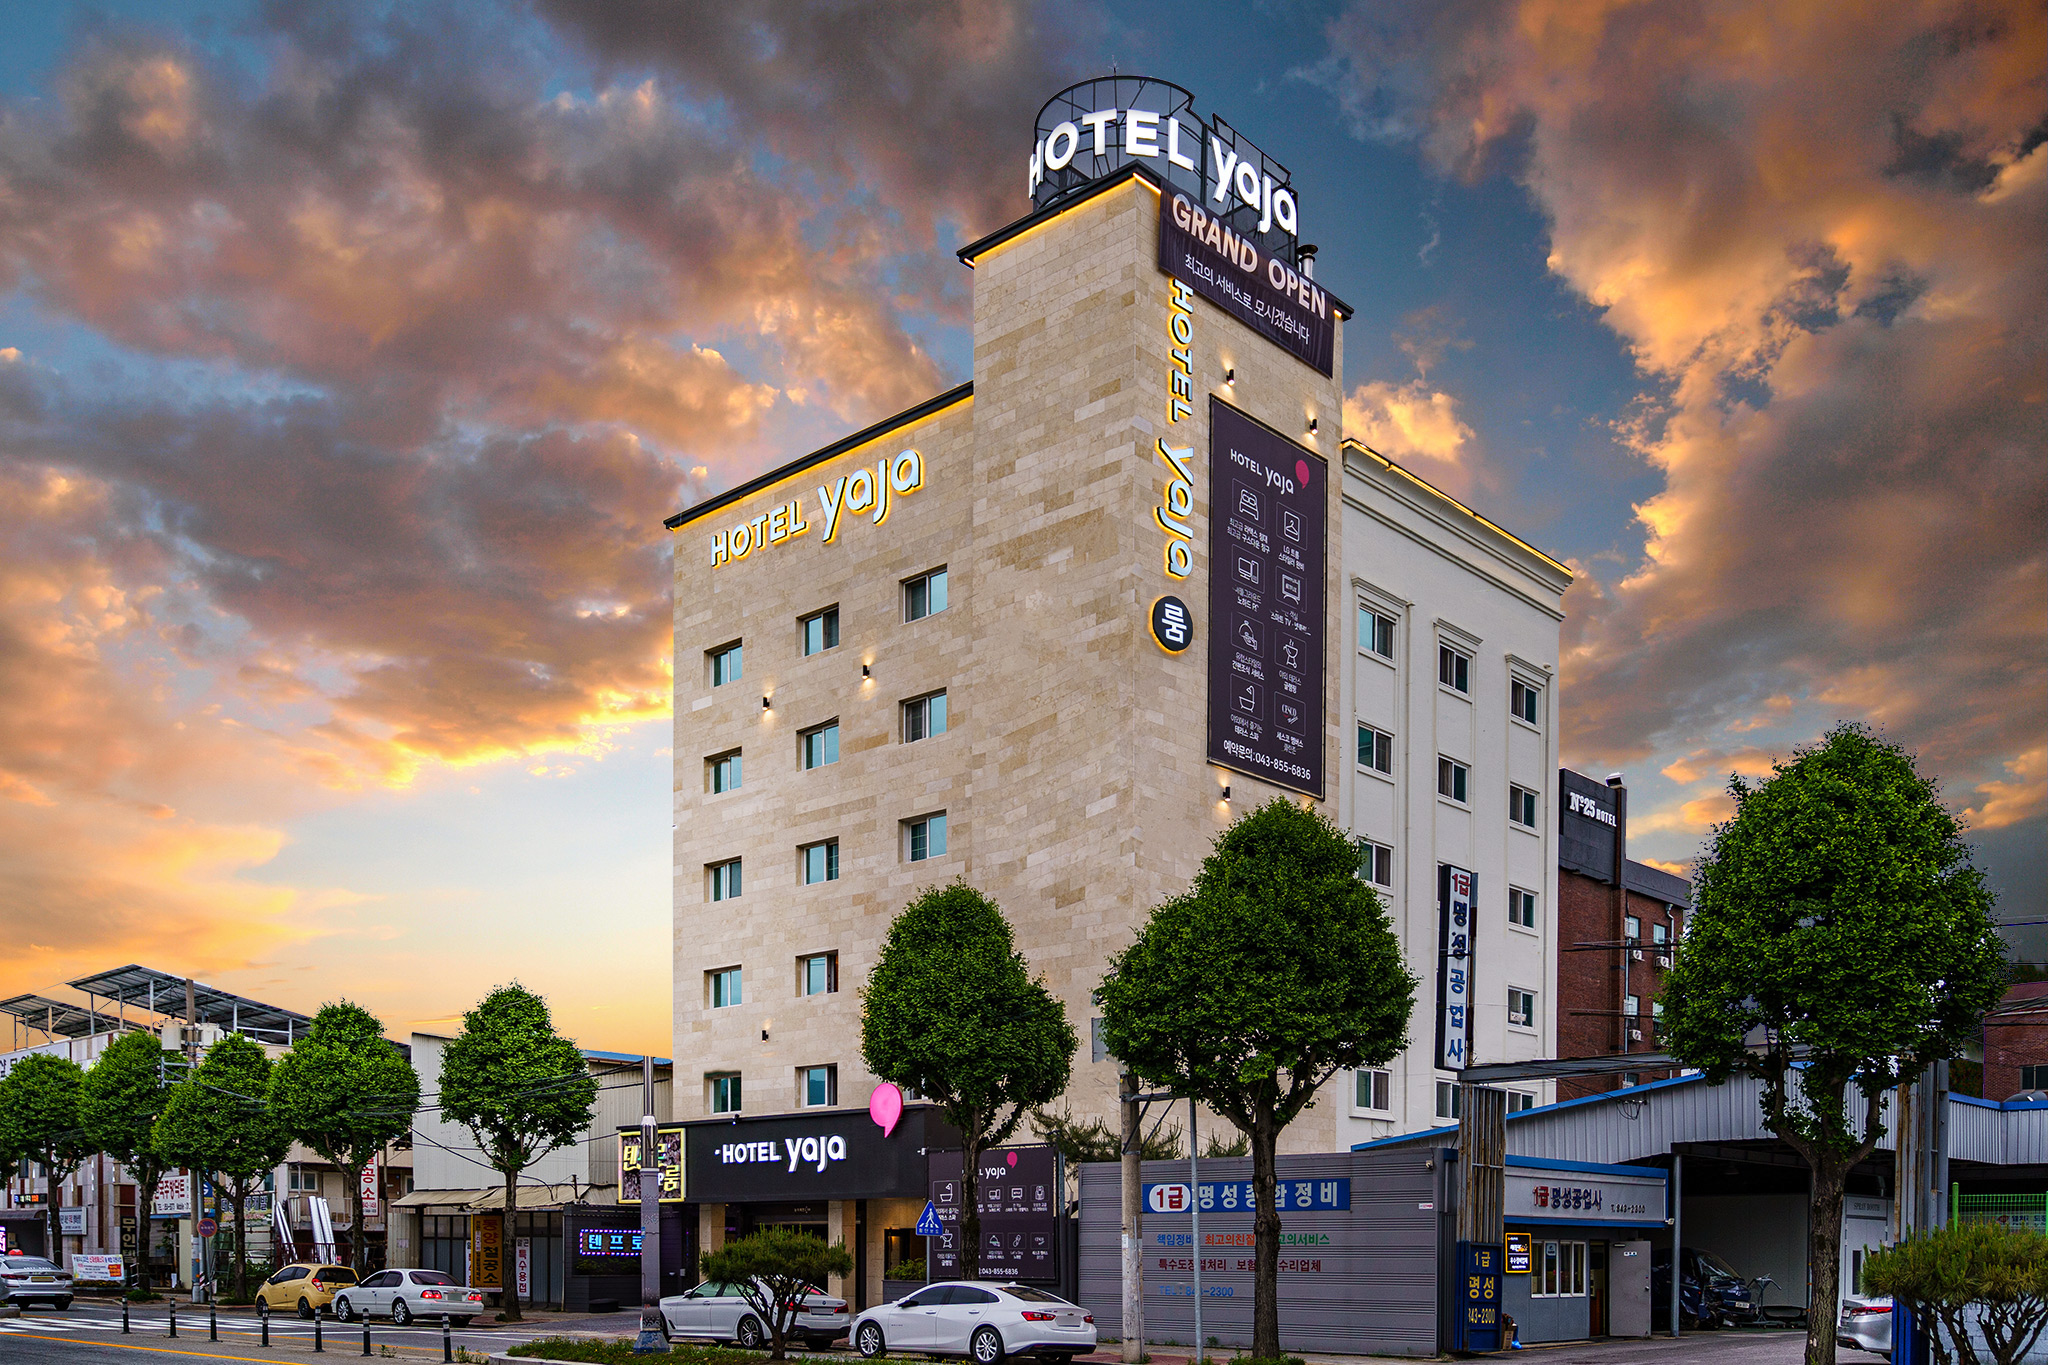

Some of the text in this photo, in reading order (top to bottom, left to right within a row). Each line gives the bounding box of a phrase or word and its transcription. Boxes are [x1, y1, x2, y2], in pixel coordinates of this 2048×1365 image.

[1029, 108, 1297, 236] HOTEL yaja
[1172, 193, 1326, 320] GRAND OPEN
[1185, 253, 1310, 345] 최고의 서비스로 모시겠습니다
[1157, 278, 1194, 577] HOTEL yaja
[1230, 448, 1294, 494] HOTEL yaja
[711, 449, 921, 567] HOTEL yaja
[1596, 808, 1617, 827] HOTEL
[1452, 873, 1470, 897] 1급
[722, 1135, 847, 1173] HOTEL yaja
[985, 1167, 1006, 1179] yaja
[1157, 1186, 1183, 1209] 1급
[1533, 1186, 1549, 1208] 1급
[1550, 1187, 1602, 1211] 명성공업사
[1475, 1251, 1490, 1267] 1급
[1469, 1276, 1494, 1299] 명성
